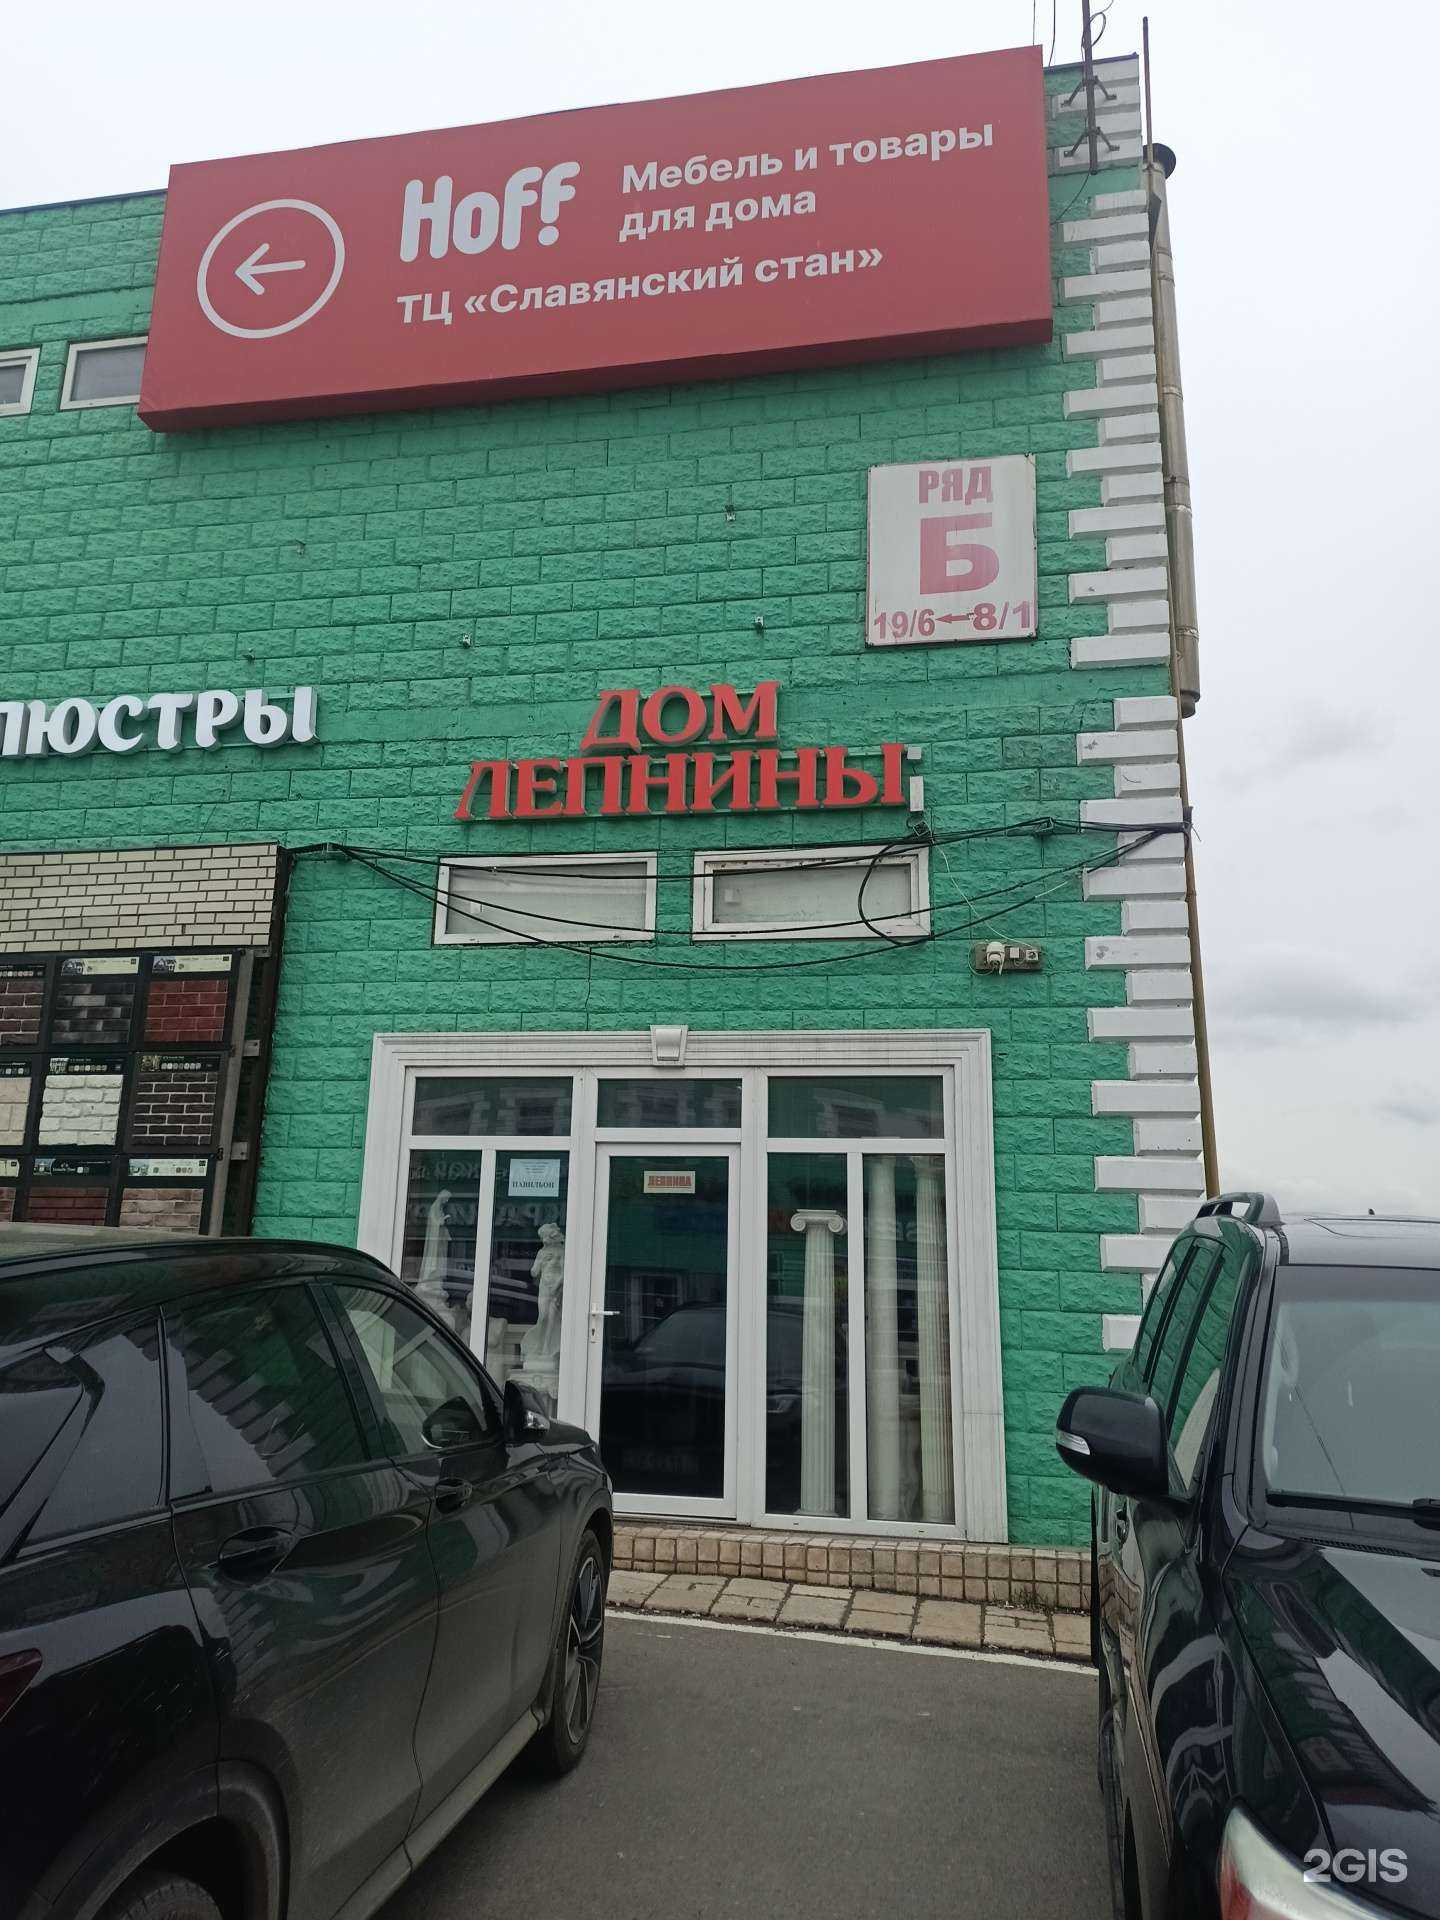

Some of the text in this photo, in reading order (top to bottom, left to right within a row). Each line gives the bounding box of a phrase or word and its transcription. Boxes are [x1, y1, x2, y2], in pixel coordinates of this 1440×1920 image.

[622, 123, 994, 194] Мебель и товары
[400, 161, 581, 262] Hoff
[618, 190, 817, 242] для дома
[397, 248, 884, 325] ТЦ «Славянский стан»
[918, 466, 994, 506] РЯД
[920, 512, 1000, 595] Б
[873, 601, 1031, 640] 19/6 8/1
[580, 680, 782, 754] ДОМ
[454, 742, 909, 822] ЛЕПНИНЫ
